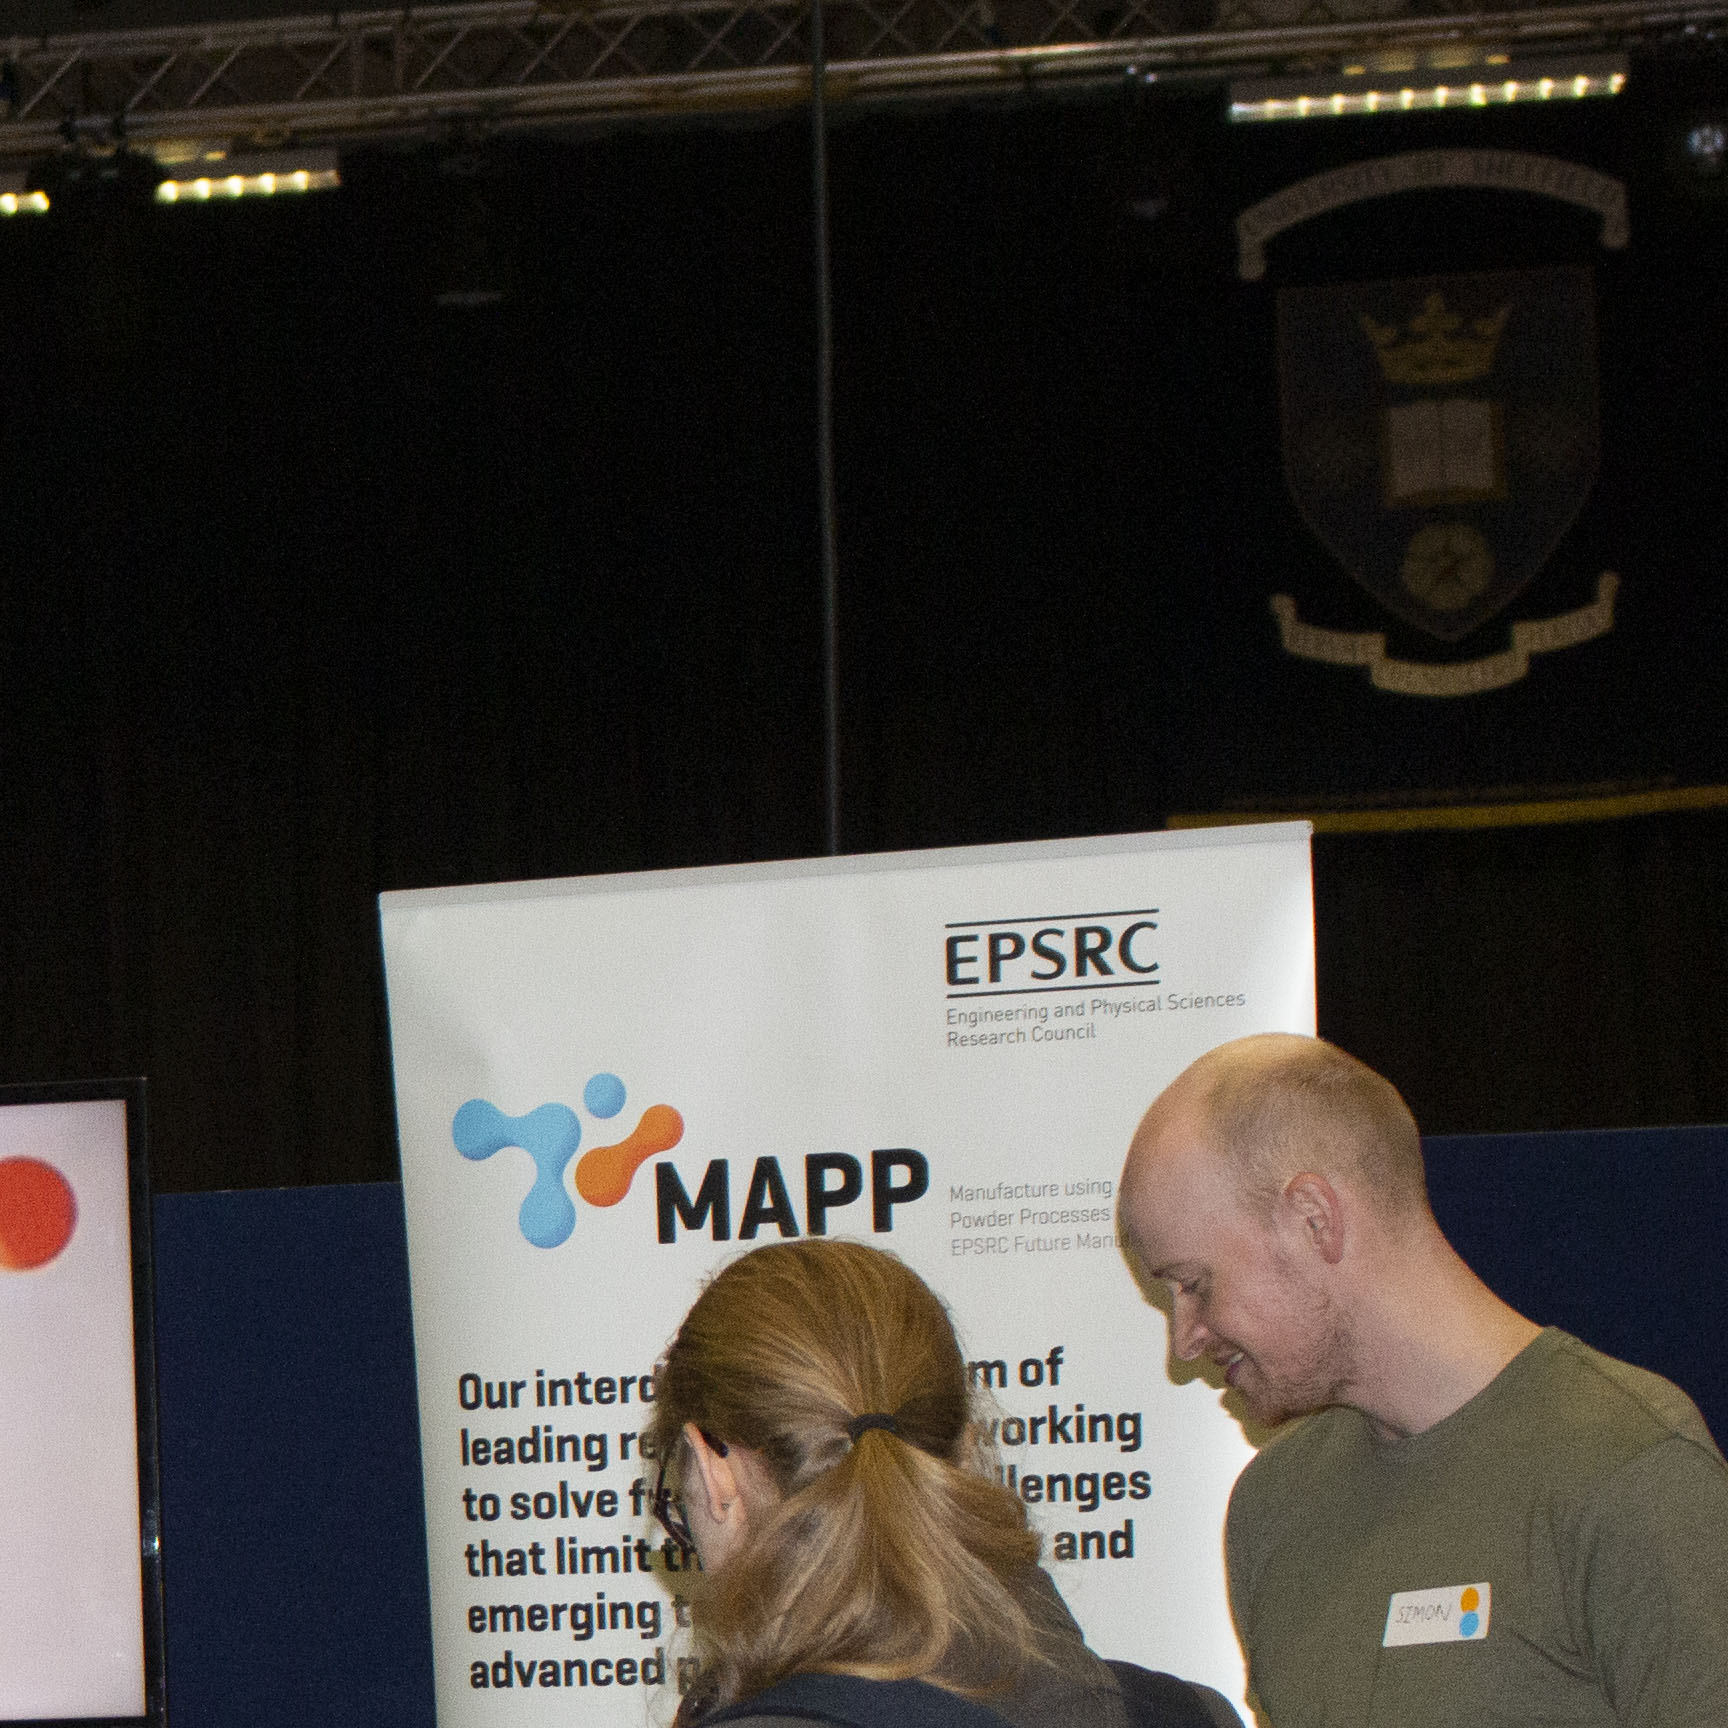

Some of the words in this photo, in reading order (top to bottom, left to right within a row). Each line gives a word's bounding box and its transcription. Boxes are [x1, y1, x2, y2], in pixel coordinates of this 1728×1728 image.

[945, 921, 1160, 986] EPSRC
[946, 1004, 1048, 1029] Engineering
[1053, 1001, 1085, 1018] and
[1091, 996, 1161, 1018] Physical
[1167, 993, 1246, 1010] Sciences
[947, 1028, 1026, 1048] Research
[1031, 1023, 1096, 1042] Council
[655, 1147, 930, 1244] MAPP
[950, 1183, 1059, 1203] Manufacture
[1064, 1179, 1112, 1199] using
[951, 1210, 1016, 1230] Powder
[1020, 1206, 1110, 1225] Processes
[951, 1236, 1009, 1257] EPSRC
[1014, 1235, 1072, 1254] Future
[458, 1372, 526, 1411] Our
[1018, 1345, 1064, 1387] of
[460, 1424, 608, 1473] leading
[462, 1487, 501, 1522] to
[510, 1479, 619, 1521] solve
[465, 1539, 546, 1577] that
[555, 1534, 652, 1575] limit
[1053, 1519, 1134, 1560] and
[467, 1591, 662, 1641] emerging
[469, 1646, 666, 1689] advanced
